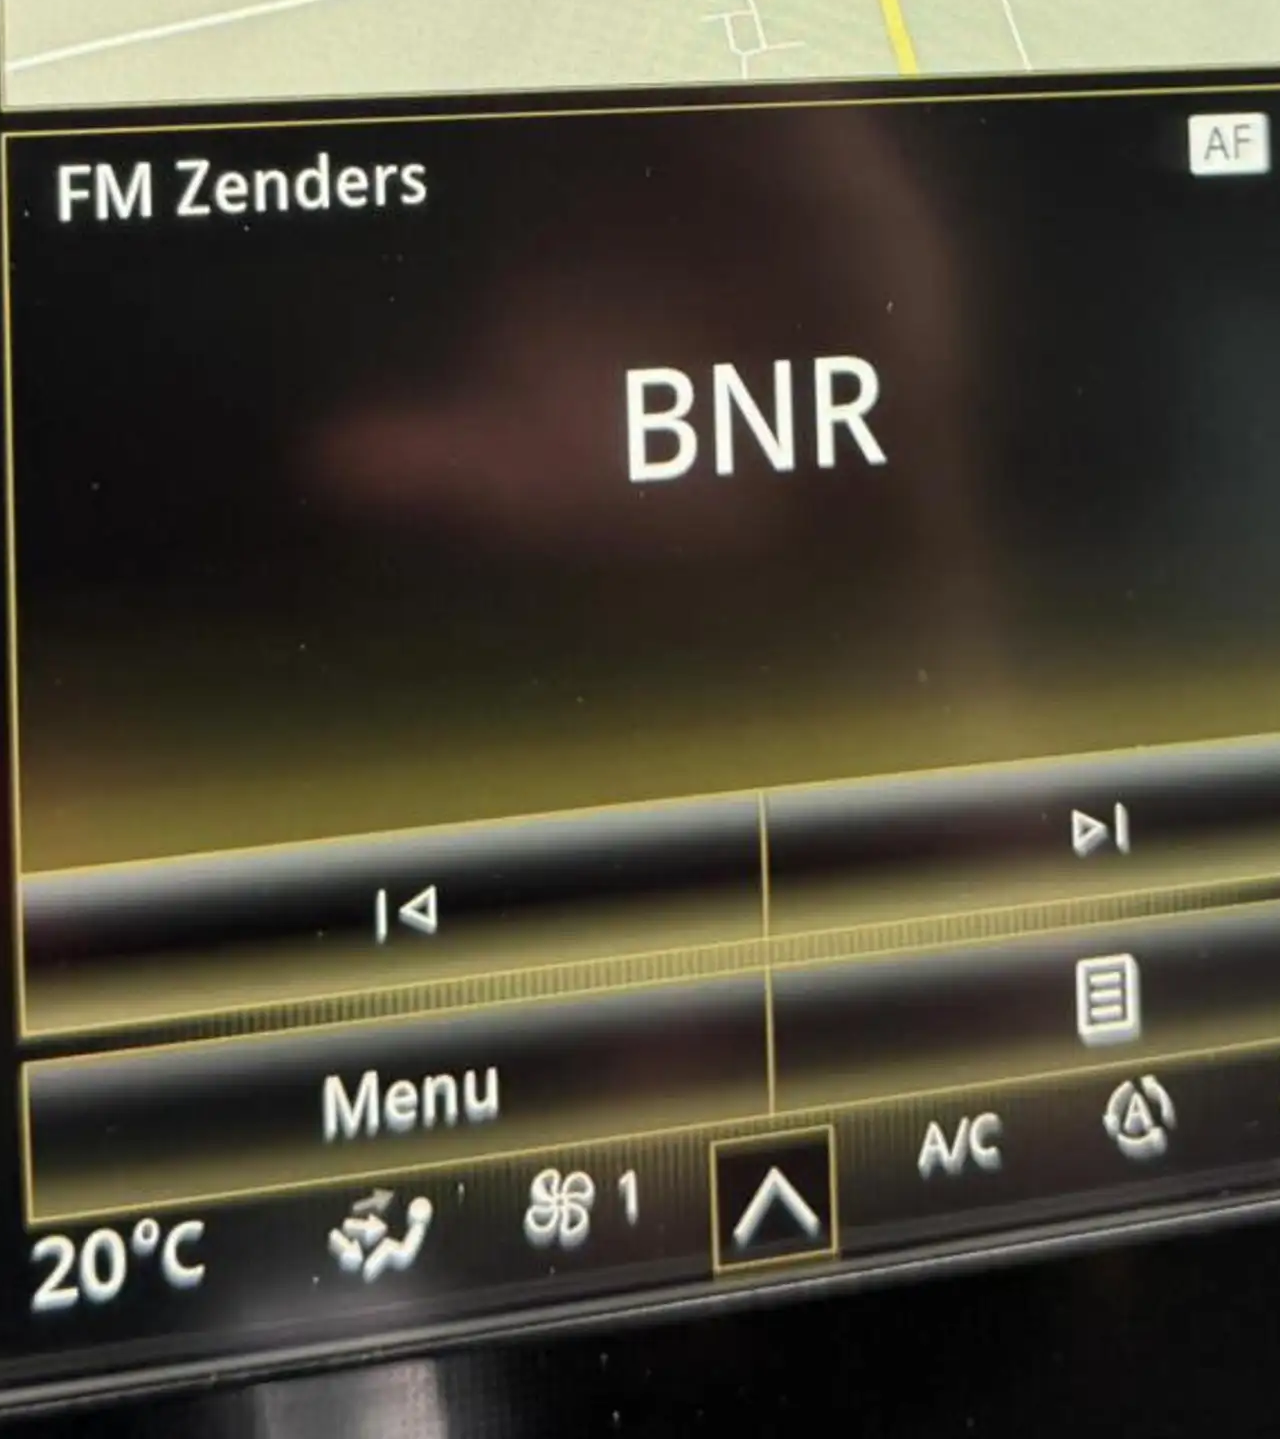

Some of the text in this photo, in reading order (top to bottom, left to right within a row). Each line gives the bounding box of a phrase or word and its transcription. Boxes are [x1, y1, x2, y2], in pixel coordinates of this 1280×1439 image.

[1204, 123, 1253, 161] AF
[56, 152, 429, 222] FM Zenders
[625, 355, 888, 482] BNR
[322, 1065, 500, 1142] Menu
[919, 1111, 1002, 1175] A/C
